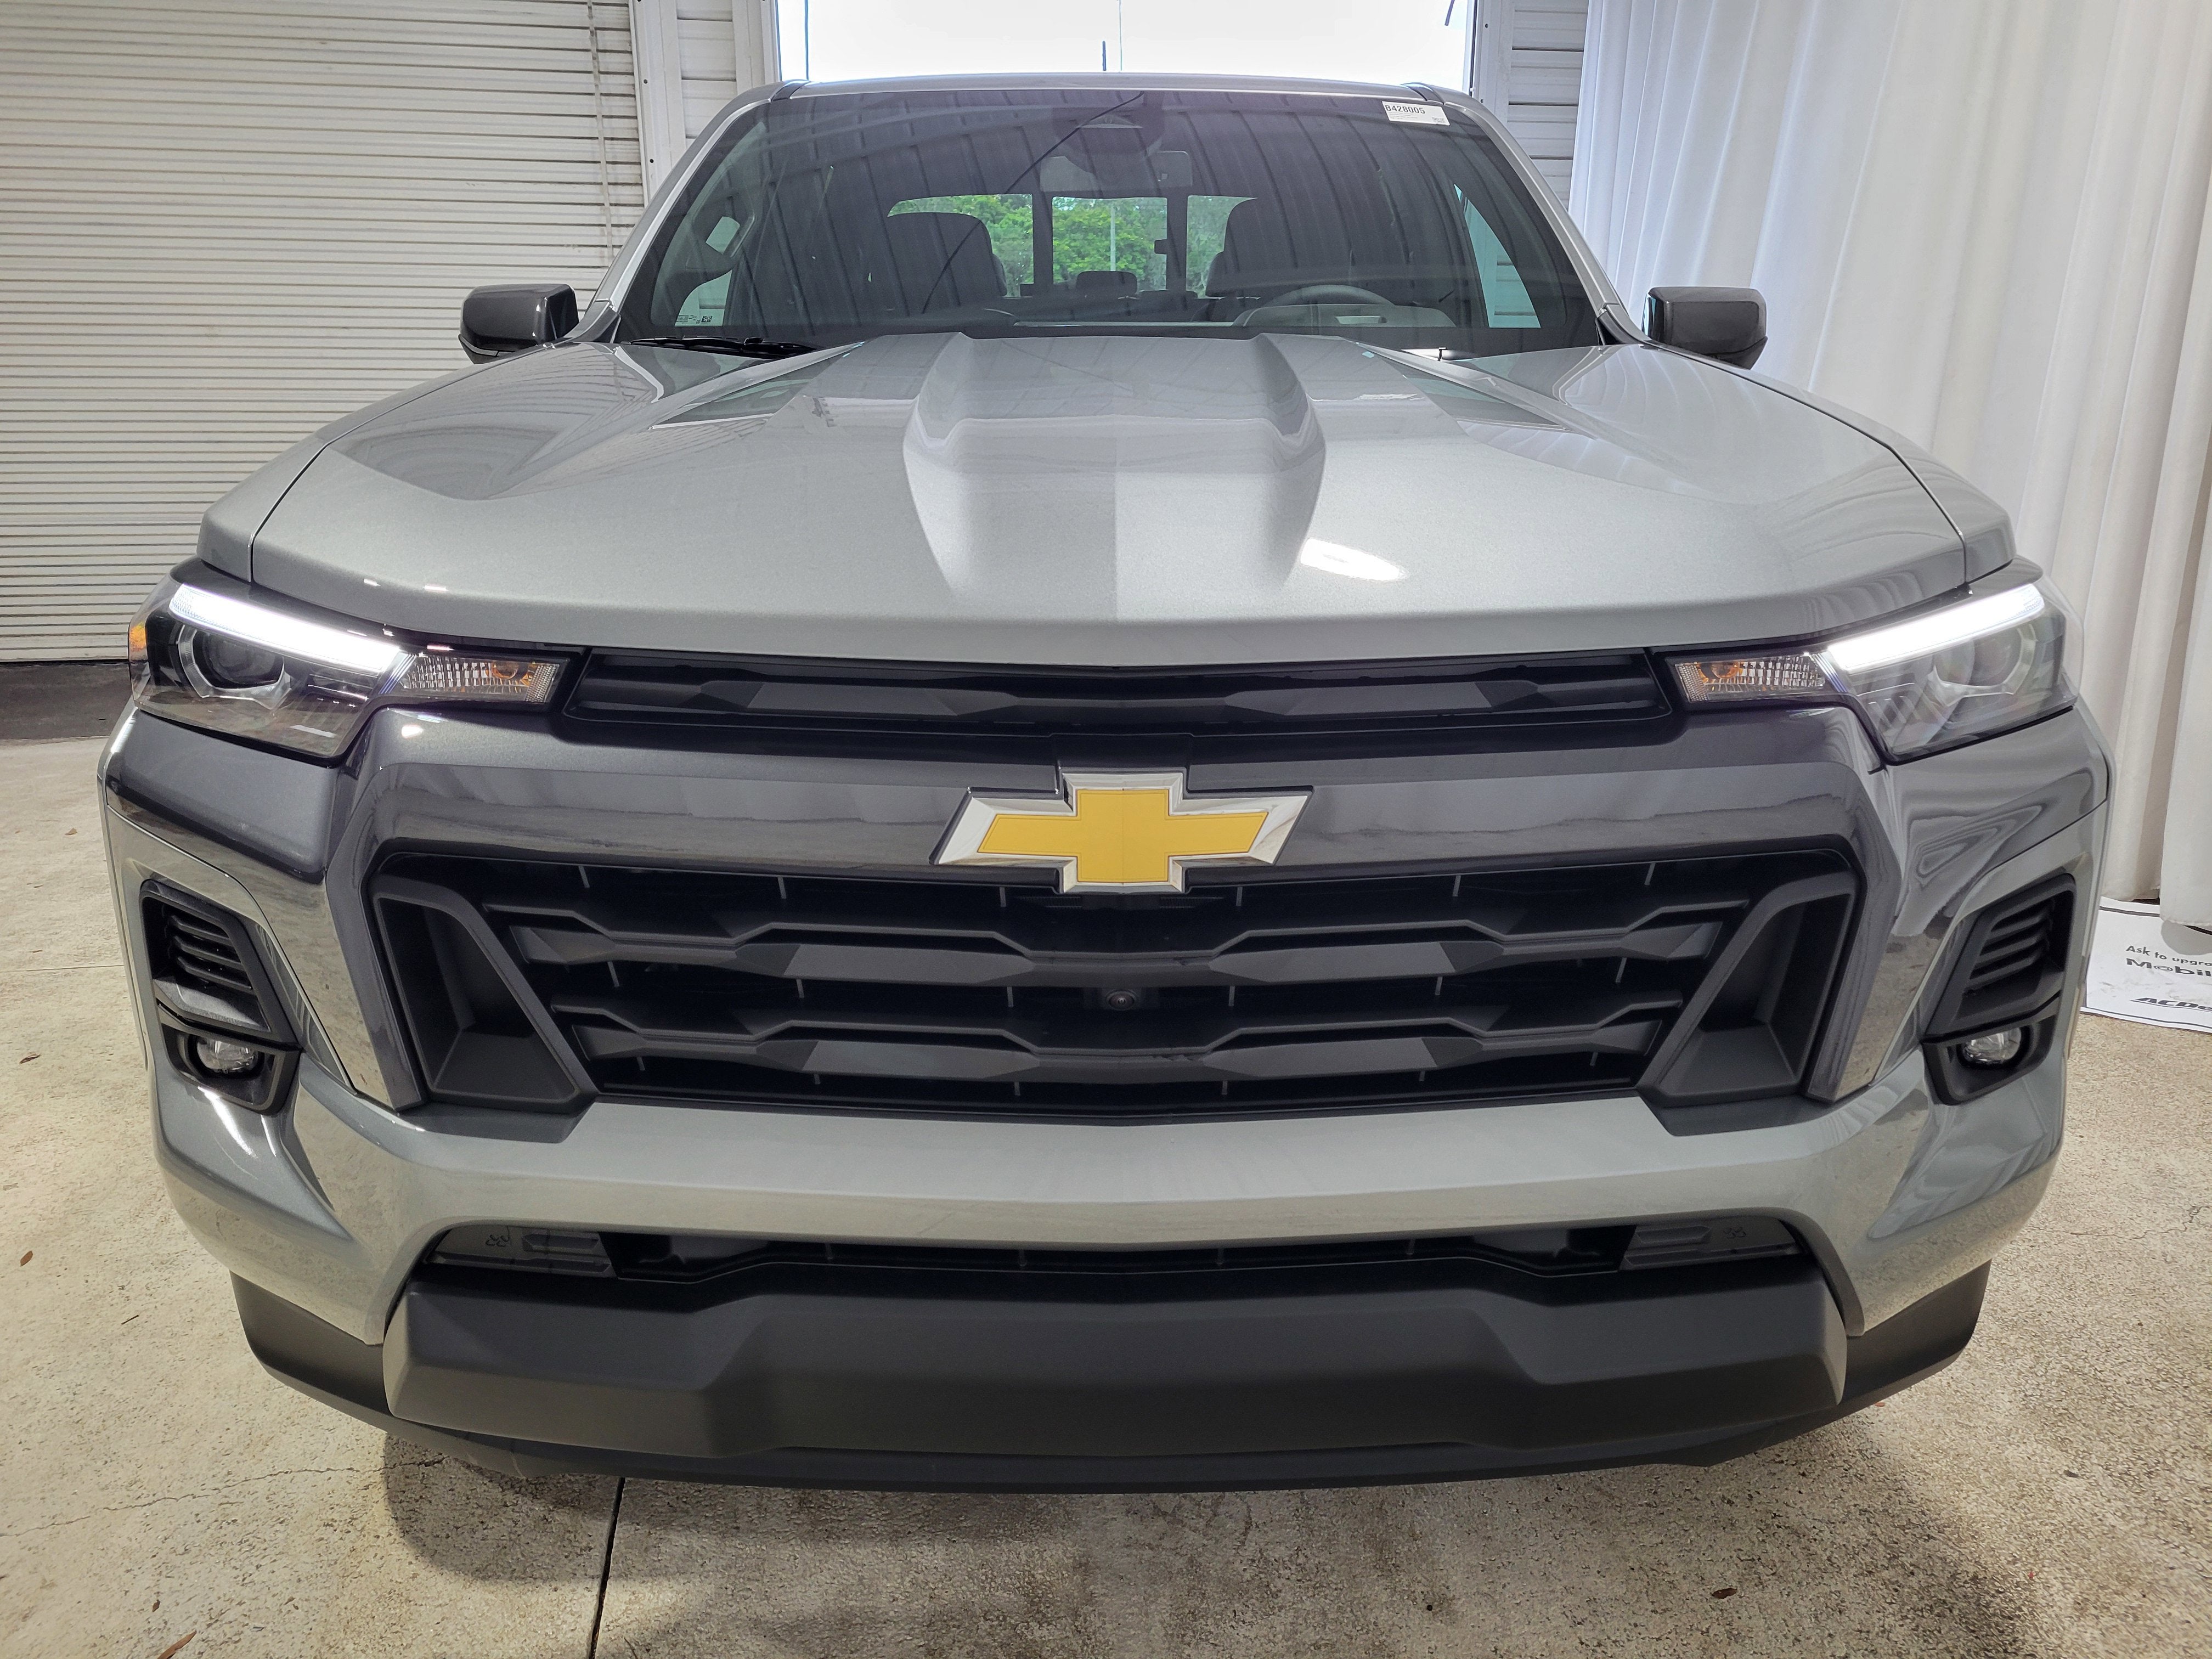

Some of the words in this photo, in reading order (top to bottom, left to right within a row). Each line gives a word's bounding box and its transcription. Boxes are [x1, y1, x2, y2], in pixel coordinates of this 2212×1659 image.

[1385, 104, 1425, 114] B428005
[2126, 945, 2151, 956] Ask
[2126, 958, 2212, 977] Mobil
